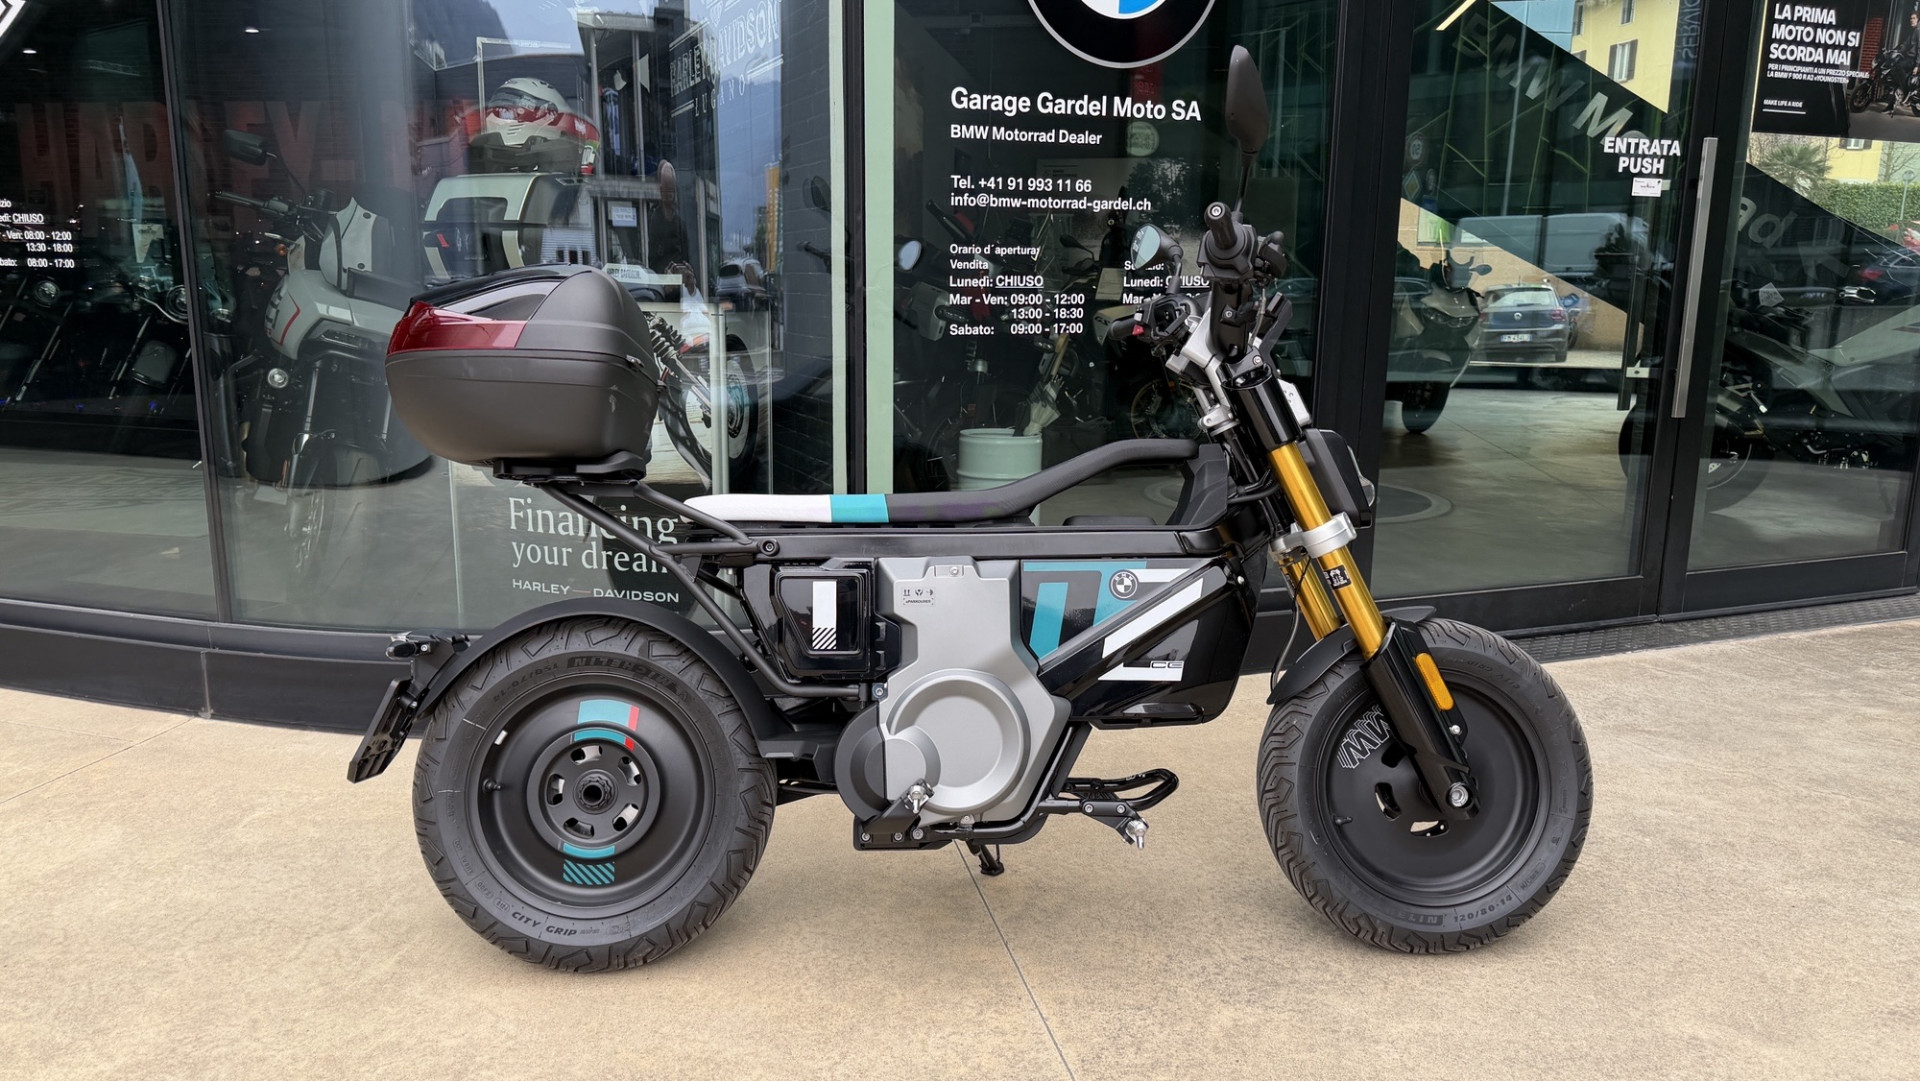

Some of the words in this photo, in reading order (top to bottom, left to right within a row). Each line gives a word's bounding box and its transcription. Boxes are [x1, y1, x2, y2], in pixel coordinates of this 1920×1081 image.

[1774, 3, 1791, 20] LA
[1793, 7, 1836, 25] PRIMA
[1771, 24, 1814, 43] MOTO
[1815, 28, 1847, 45] NON
[1847, 32, 1860, 47] SI
[1769, 43, 1824, 63] SCORDA
[1825, 50, 1851, 66] MAI
[1774, 71, 1788, 79] BMW
[1781, 64, 1814, 73] PRINCIPIANTI
[1826, 68, 1846, 76] PREZZO
[951, 86, 1031, 117] Garage
[1037, 92, 1107, 116] Gardel
[1113, 96, 1166, 119] Moto
[1171, 99, 1202, 121] SA
[950, 124, 989, 140] BMW
[992, 126, 1056, 143] Motorrad
[1058, 129, 1103, 145] Dealer
[1603, 137, 1681, 156] ENTRATA
[1618, 156, 1665, 174] PUSH
[950, 174, 975, 189] Tel.
[978, 176, 1003, 190] +41
[1007, 177, 1023, 191] 91
[1027, 177, 1053, 192] 993
[1056, 179, 1071, 192] 11
[1075, 179, 1092, 193] 66
[950, 192, 1152, 213] info@bmw-motorrad-gardel.ch
[12, 213, 44, 224] CHIUSO
[51, 231, 72, 241] 12:00
[53, 243, 73, 253] 18:00
[949, 243, 982, 255] Orario
[54, 259, 75, 269] 17:00
[949, 258, 989, 270] Vendita
[995, 275, 1044, 289] CHIUSO
[949, 293, 973, 305] Mar
[982, 293, 1008, 305] Ven:
[1010, 293, 1043, 305] 09:00
[1054, 293, 1087, 305] 12:00
[1011, 308, 1043, 319] 13:00
[1053, 307, 1085, 319] 18:30
[949, 323, 995, 336] Sabato:
[1010, 323, 1043, 335] 09:00
[1053, 322, 1085, 335] 17:00
[512, 541, 572, 568] your
[512, 578, 570, 595] HARLEY
[593, 587, 679, 603] DAVIDSON
[511, 911, 542, 928] CITY
[545, 924, 578, 937] GRIP
